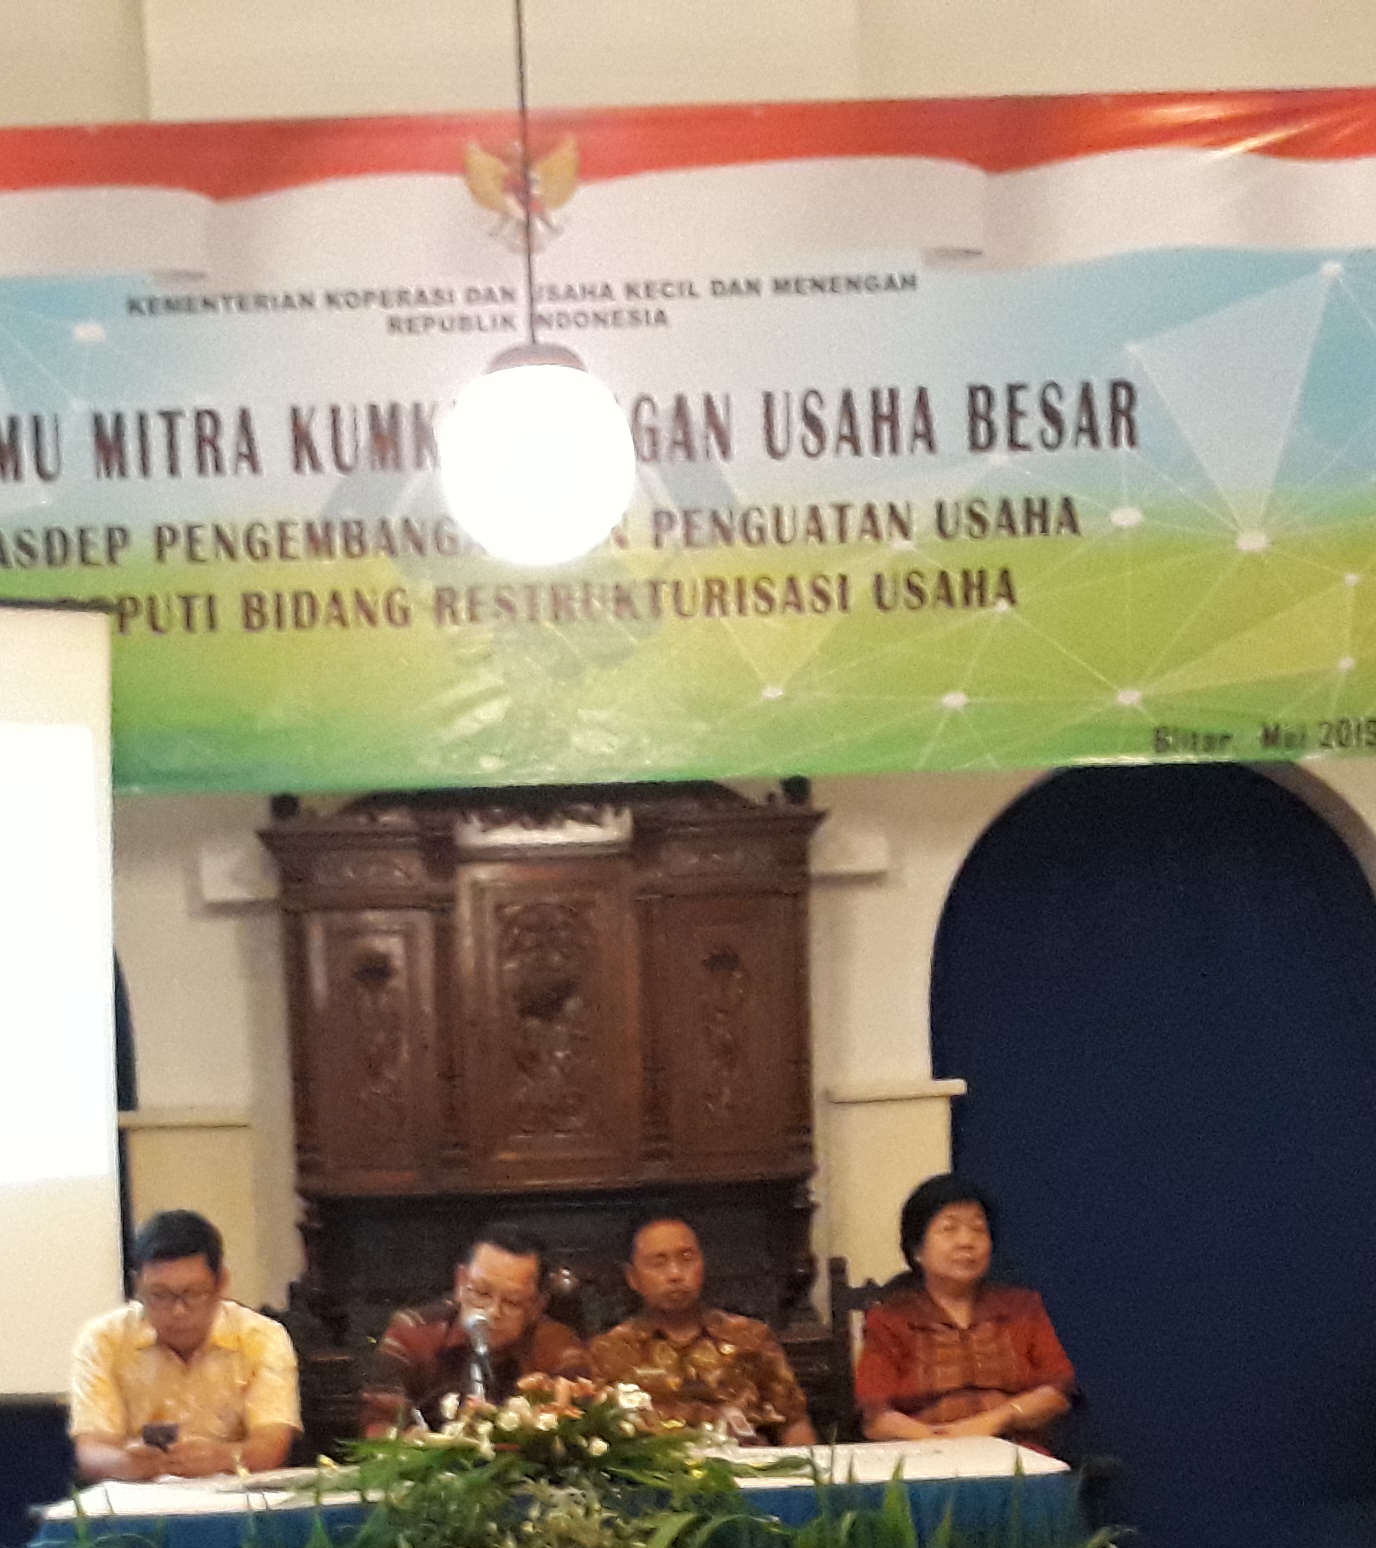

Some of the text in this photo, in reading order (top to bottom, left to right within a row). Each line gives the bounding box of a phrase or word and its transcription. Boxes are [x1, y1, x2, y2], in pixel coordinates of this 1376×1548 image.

[128, 291, 316, 316] KEMENTERIAN
[325, 285, 455, 309] KOPERASI
[467, 284, 516, 306] DAN
[626, 279, 700, 301] KECIL
[711, 276, 762, 298] DAN
[773, 272, 918, 297] MENENGAH
[387, 308, 670, 335] REPUBLIK NDONESIA
[93, 406, 264, 480] MITRA
[290, 400, 442, 476] KUMK
[761, 386, 937, 461] USAHA
[967, 379, 1140, 453] BESAR
[156, 514, 484, 565] PENGEMBANG
[651, 502, 913, 550] PENGUATAN
[935, 496, 1083, 541] USAHA
[58, 567, 1019, 635] PUTI BIDANG RESTRUKTURISASI USAHA
